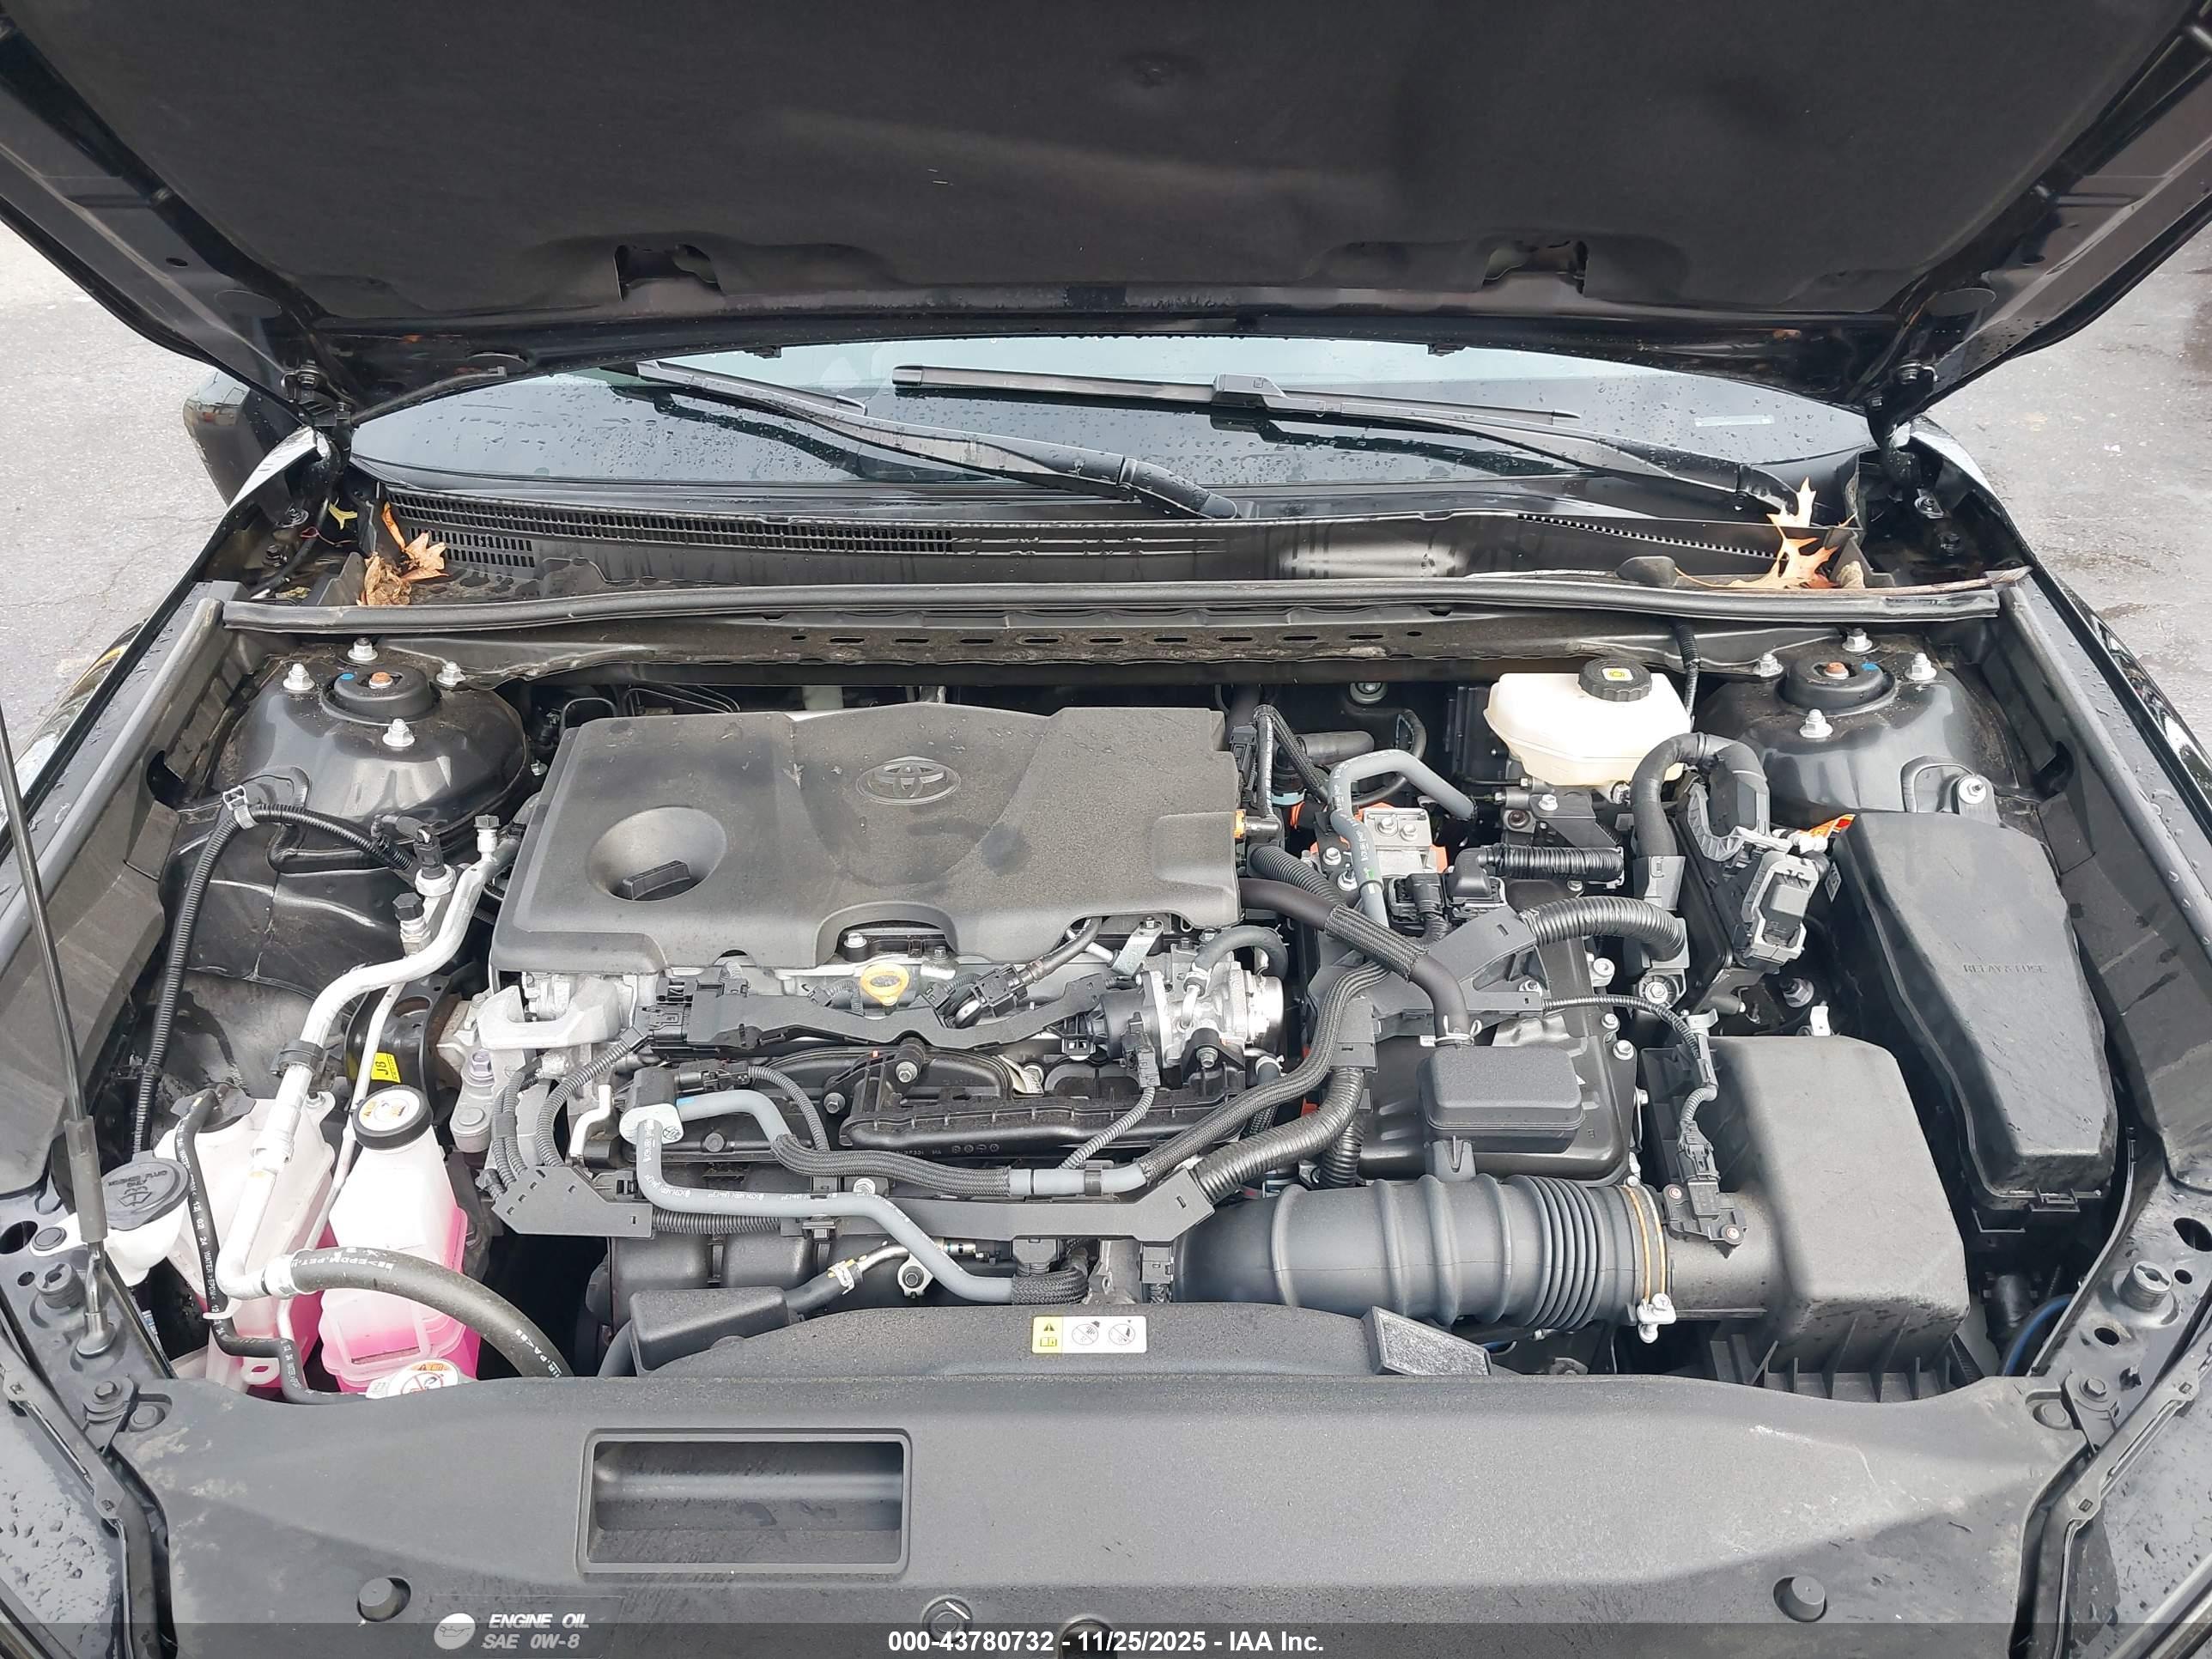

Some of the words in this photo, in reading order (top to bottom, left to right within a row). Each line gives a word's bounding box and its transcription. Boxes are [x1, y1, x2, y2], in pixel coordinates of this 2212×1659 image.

[204, 1250, 214, 1273] WATER
[489, 1613, 554, 1629] ENGINE
[562, 1613, 590, 1629] OIL
[481, 1633, 520, 1649] SAE
[530, 1633, 580, 1649] 0W-8
